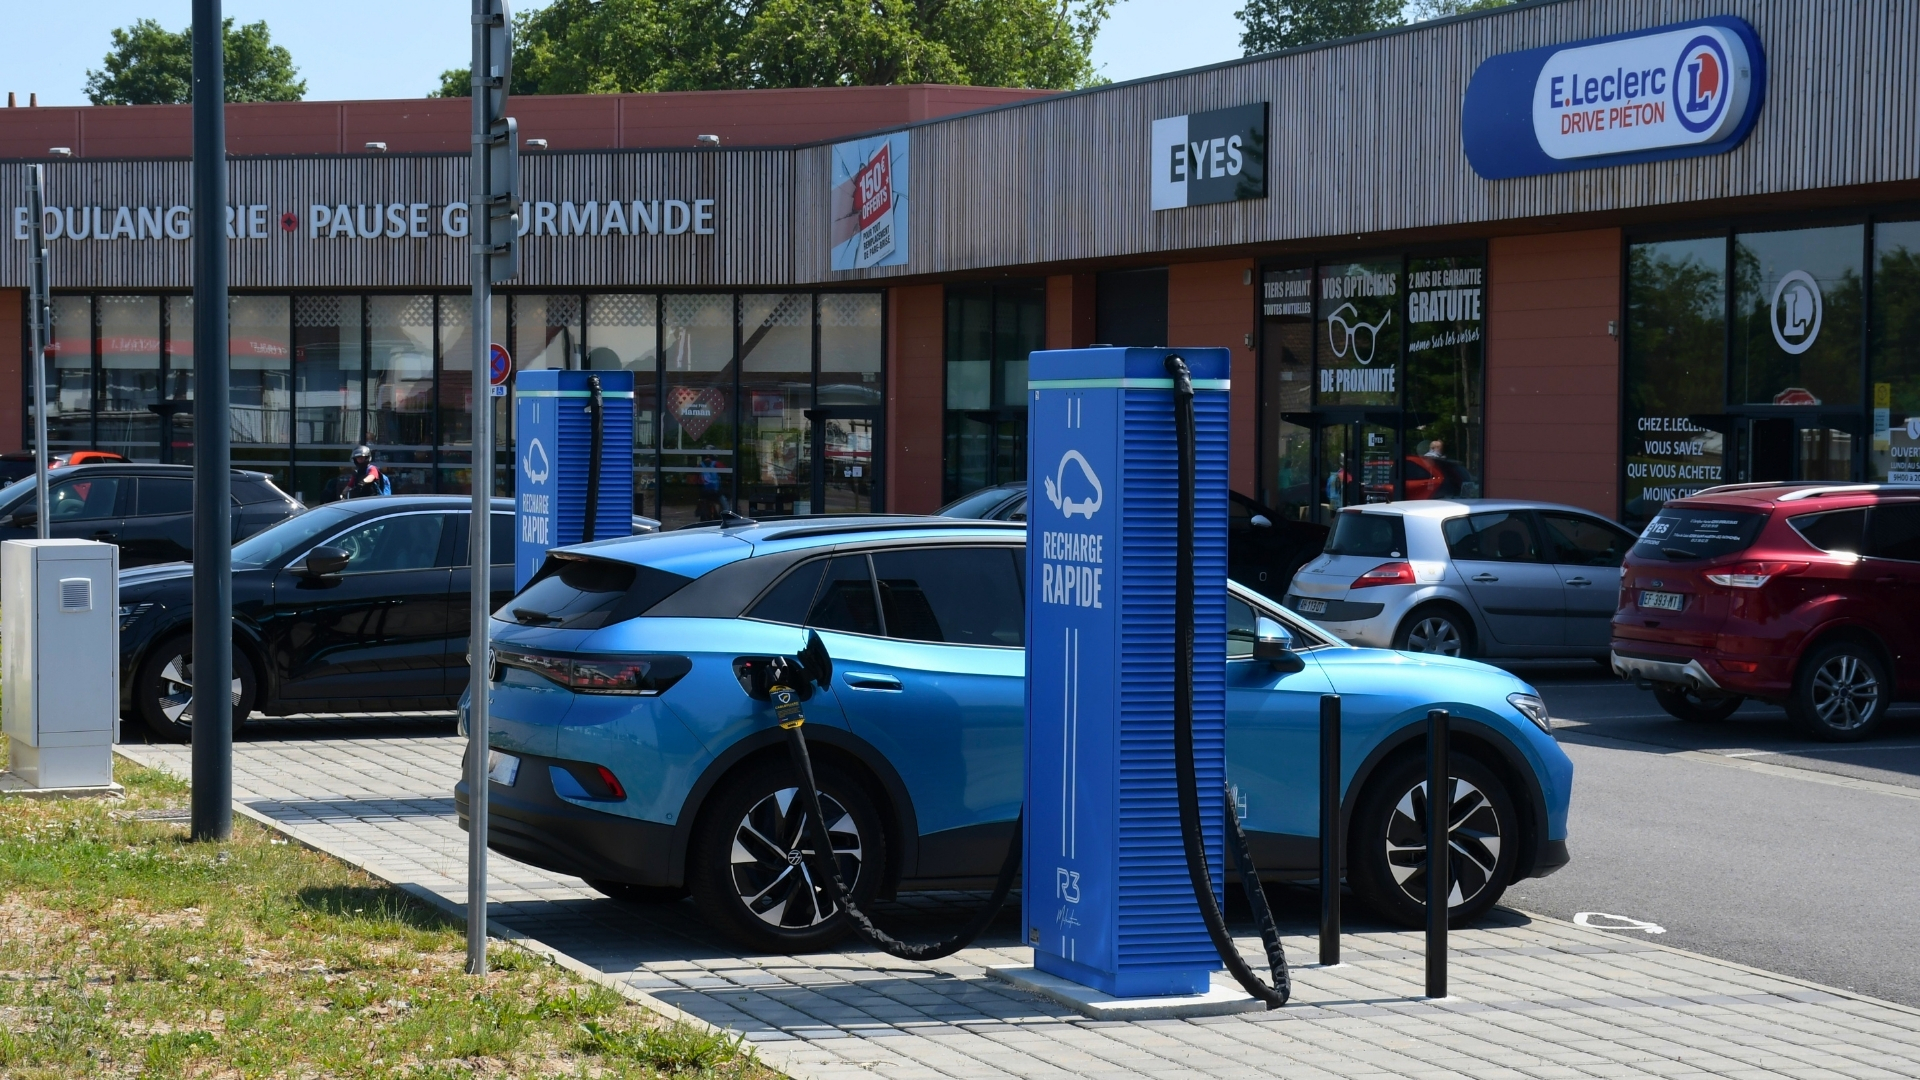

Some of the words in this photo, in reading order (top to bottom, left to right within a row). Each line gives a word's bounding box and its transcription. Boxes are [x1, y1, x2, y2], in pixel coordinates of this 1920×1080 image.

[1550, 67, 1666, 109] E.Leclerc
[1561, 109, 1605, 135] DRIVE
[1609, 100, 1665, 129] PIÉTON
[1170, 134, 1243, 183] EYES
[311, 202, 429, 239] PAUSE
[442, 199, 715, 237] GURMANDE
[863, 227, 872, 240] POUR
[872, 221, 881, 234] TOUT
[863, 224, 890, 250] REMPLACEMENT
[864, 250, 869, 260] DE
[1264, 281, 1284, 299] TIERS
[1284, 279, 1312, 298] PAYANT
[1322, 276, 1341, 300] VOS
[1343, 273, 1396, 298] OPTICIENS
[1408, 272, 1414, 289] 2
[1415, 270, 1430, 289] ANS
[1432, 270, 1442, 287] DE
[1443, 268, 1482, 286] GARANTIE
[1264, 303, 1282, 316] TOUTES
[1282, 302, 1311, 315] MUTUELLES
[1408, 288, 1481, 324] GRATUITE
[1320, 368, 1334, 393] DE
[1336, 364, 1395, 393] PROXIMITÉ
[681, 408, 711, 416] Maman
[1637, 417, 1662, 432] CHEZ
[1645, 441, 1672, 455] VOUS
[1673, 441, 1704, 456] SAVEZ
[1627, 463, 1647, 479] QUE
[1649, 464, 1676, 478] VOUS
[1678, 465, 1722, 480] ACHETEZ
[522, 493, 549, 514] RECHARGE
[1643, 486, 1676, 501] MOINS
[522, 514, 549, 545] RAPIDE
[1646, 523, 1669, 534] EYES
[1043, 531, 1103, 563] RECHARGE
[1042, 563, 1103, 609] RAPIDE
